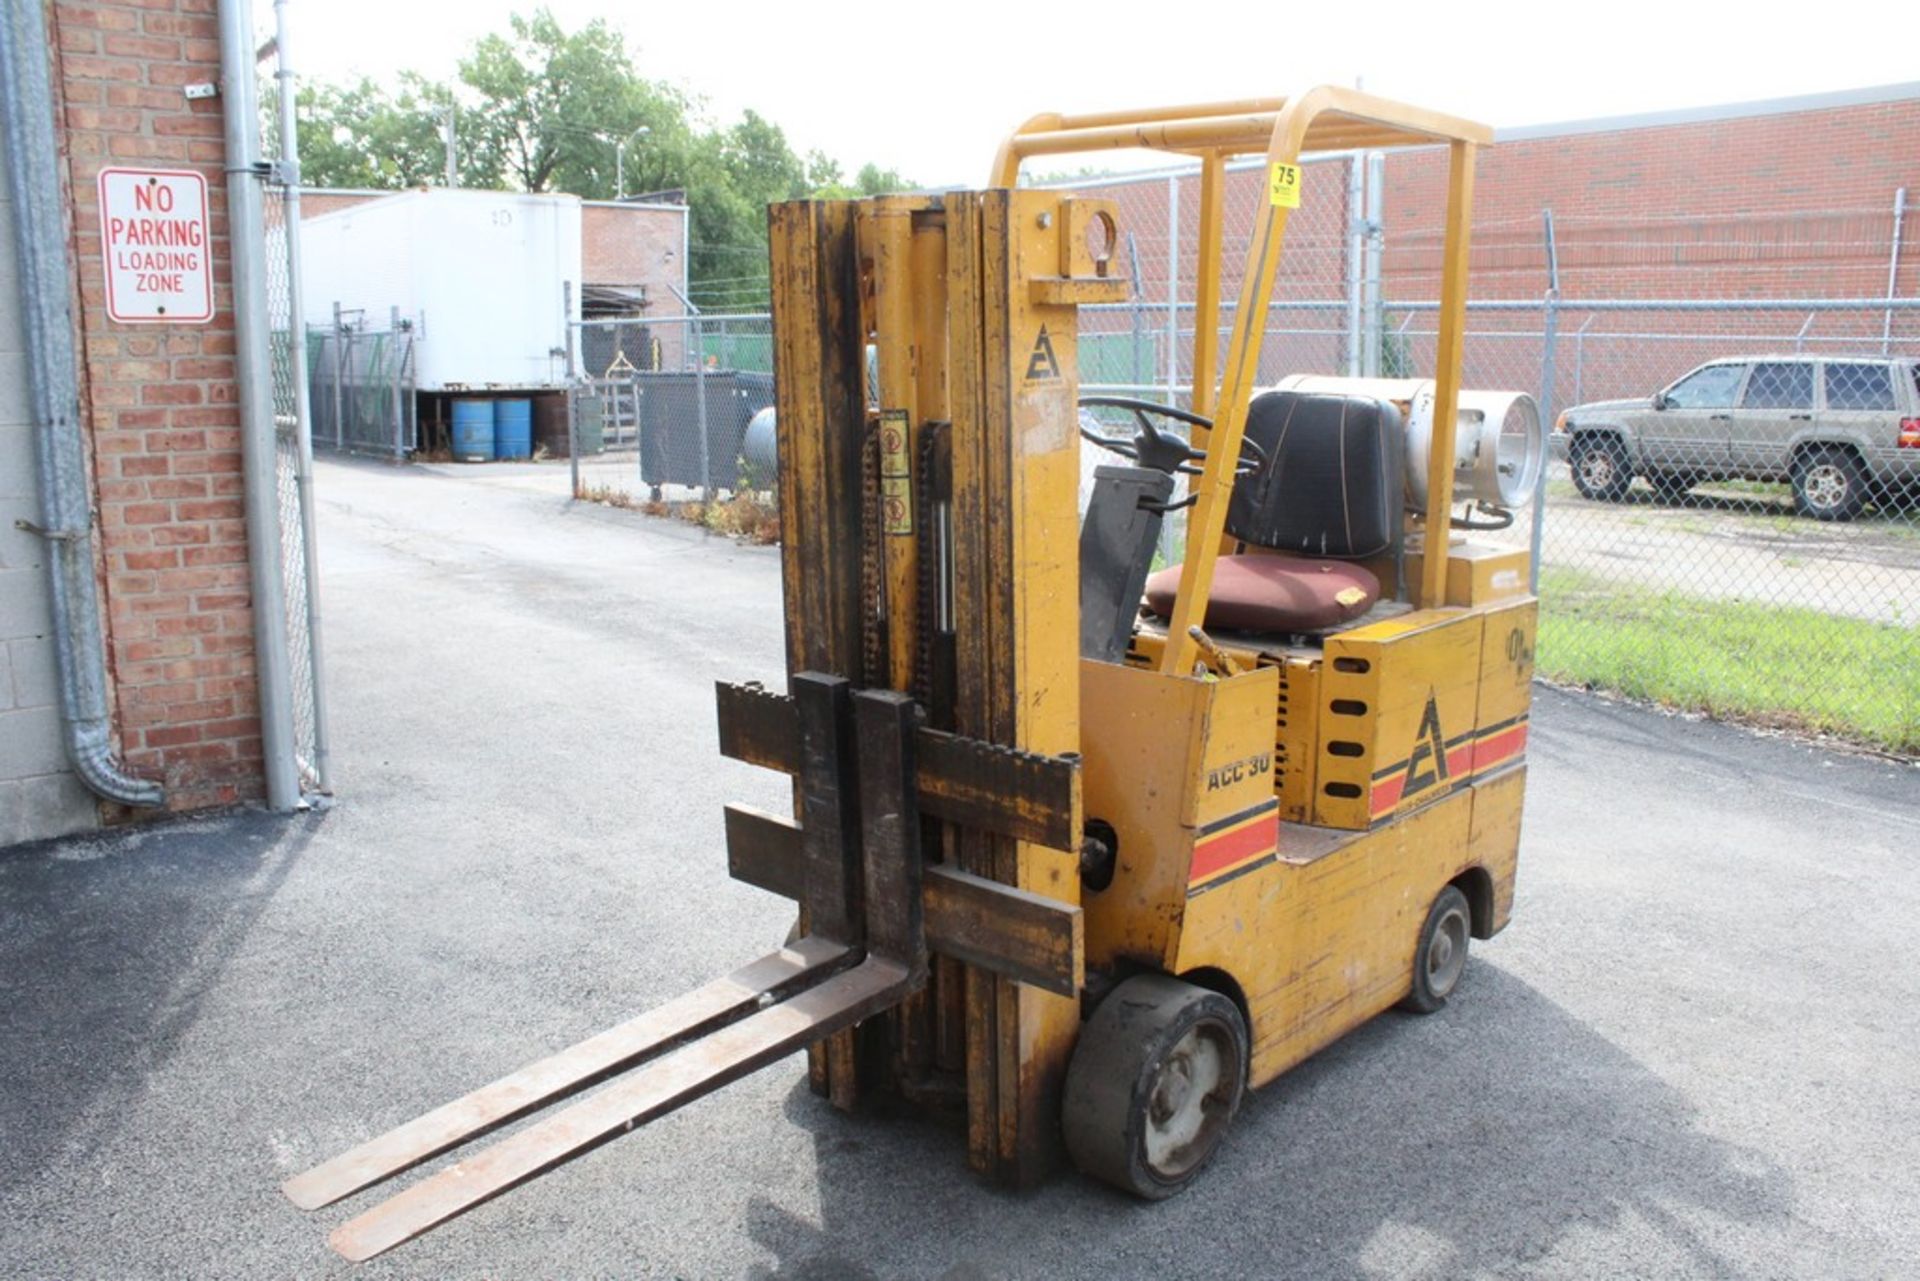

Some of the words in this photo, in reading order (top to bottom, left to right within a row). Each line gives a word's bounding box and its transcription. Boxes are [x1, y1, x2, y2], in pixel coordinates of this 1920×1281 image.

[1278, 165, 1295, 185] 75
[135, 184, 173, 212] NO
[111, 217, 201, 247] PARKING
[118, 251, 198, 271] LOADING
[136, 274, 184, 292] ZONE
[1207, 765, 1244, 792] ACC
[1248, 755, 1270, 778] 30
